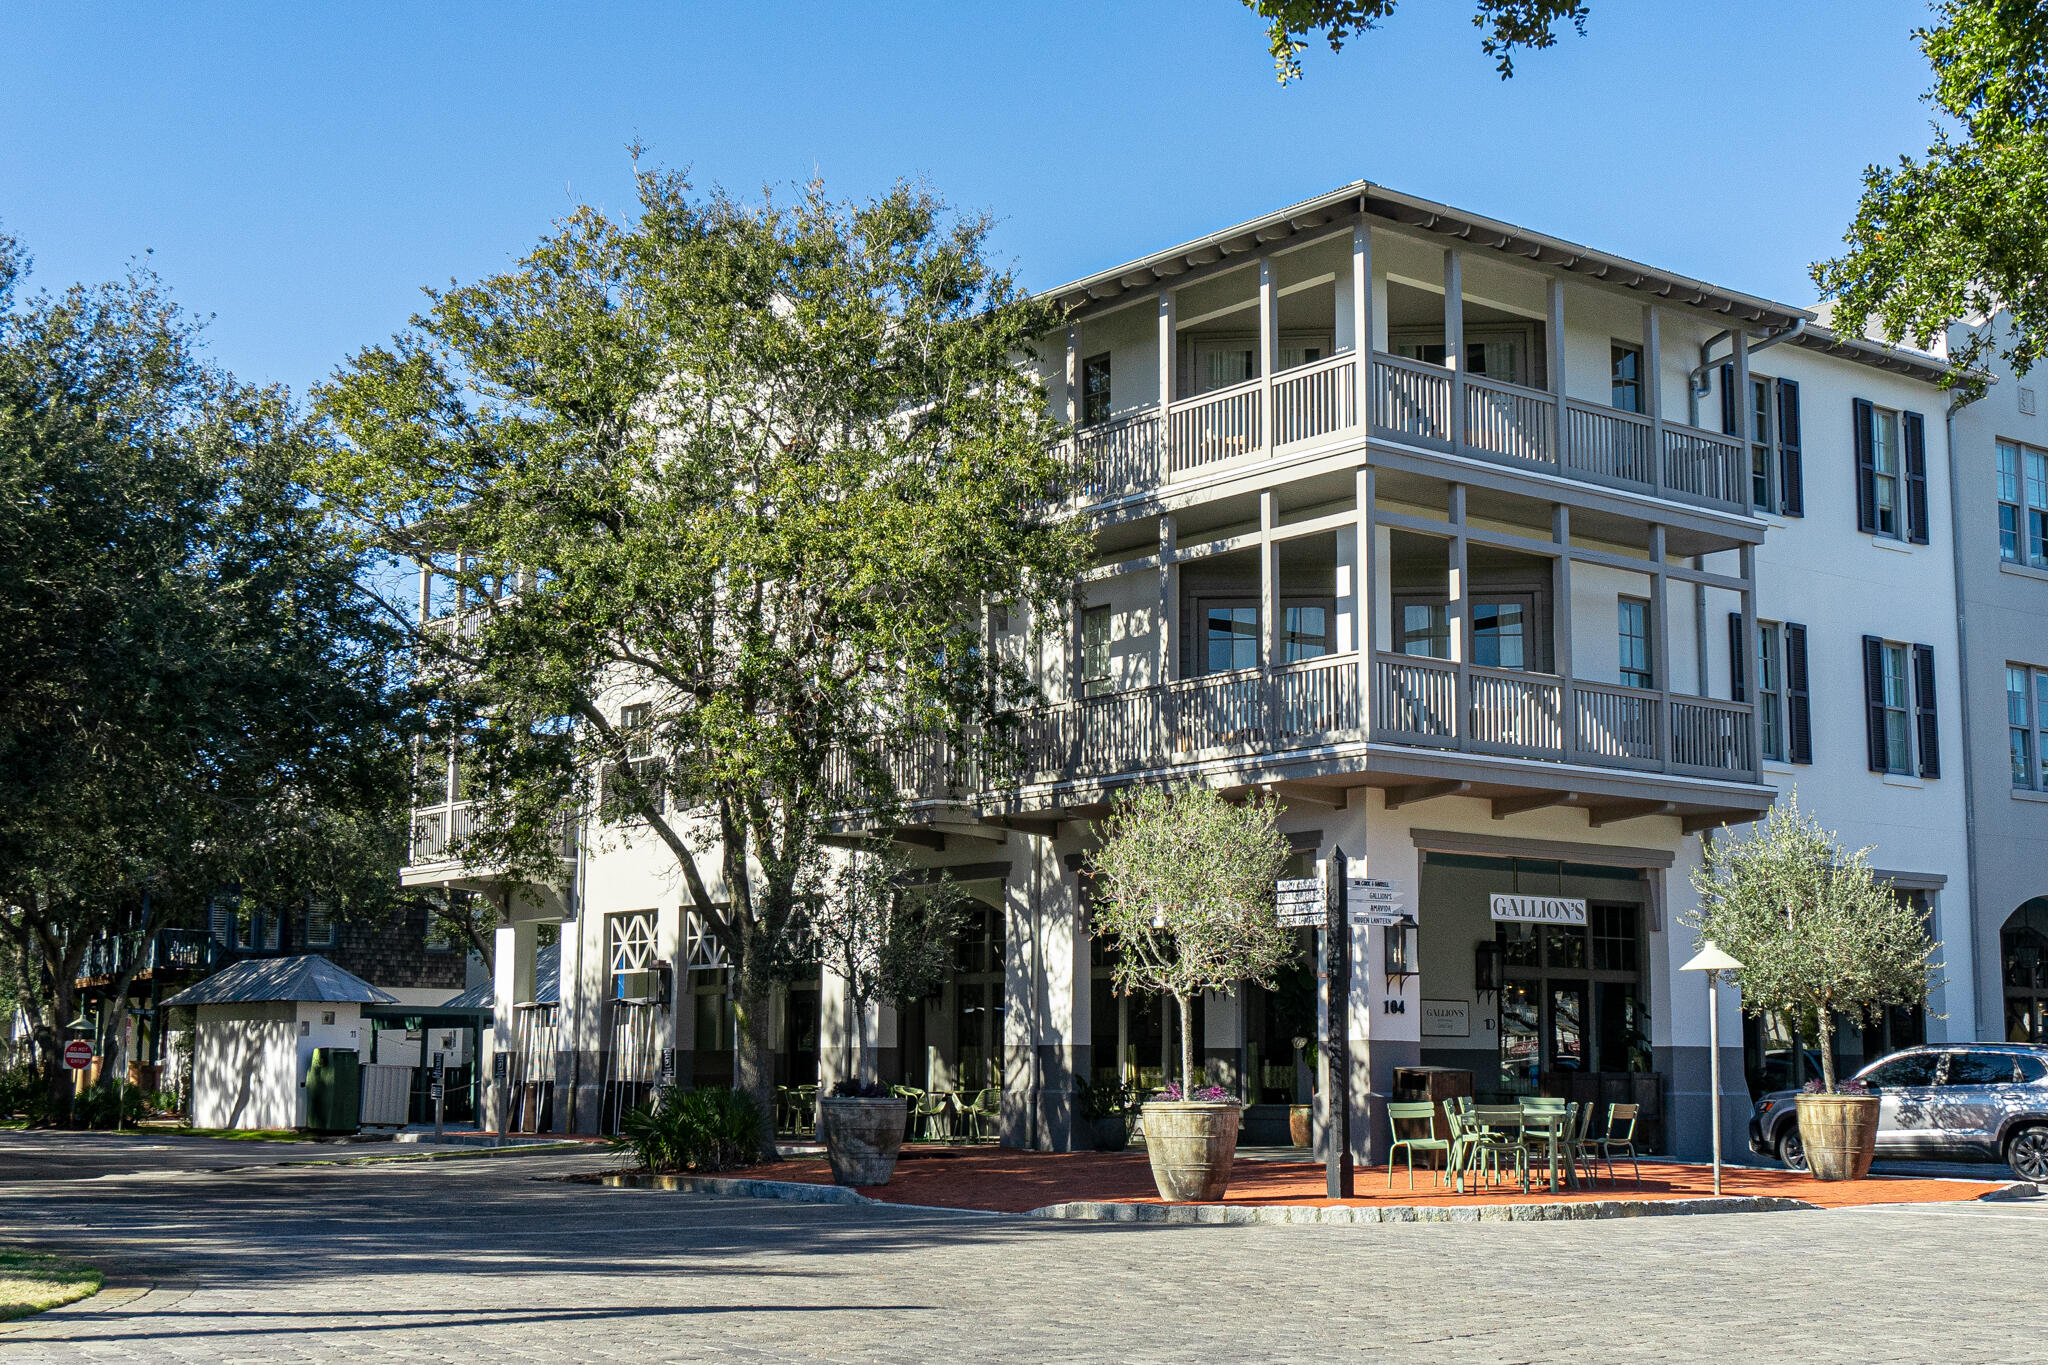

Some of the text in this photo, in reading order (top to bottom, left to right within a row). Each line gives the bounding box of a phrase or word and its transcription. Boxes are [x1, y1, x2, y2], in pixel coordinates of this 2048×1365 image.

[1493, 897, 1585, 921] GALLION'S
[1371, 916, 1392, 924] LANTERN
[1383, 1000, 1405, 1014] 104
